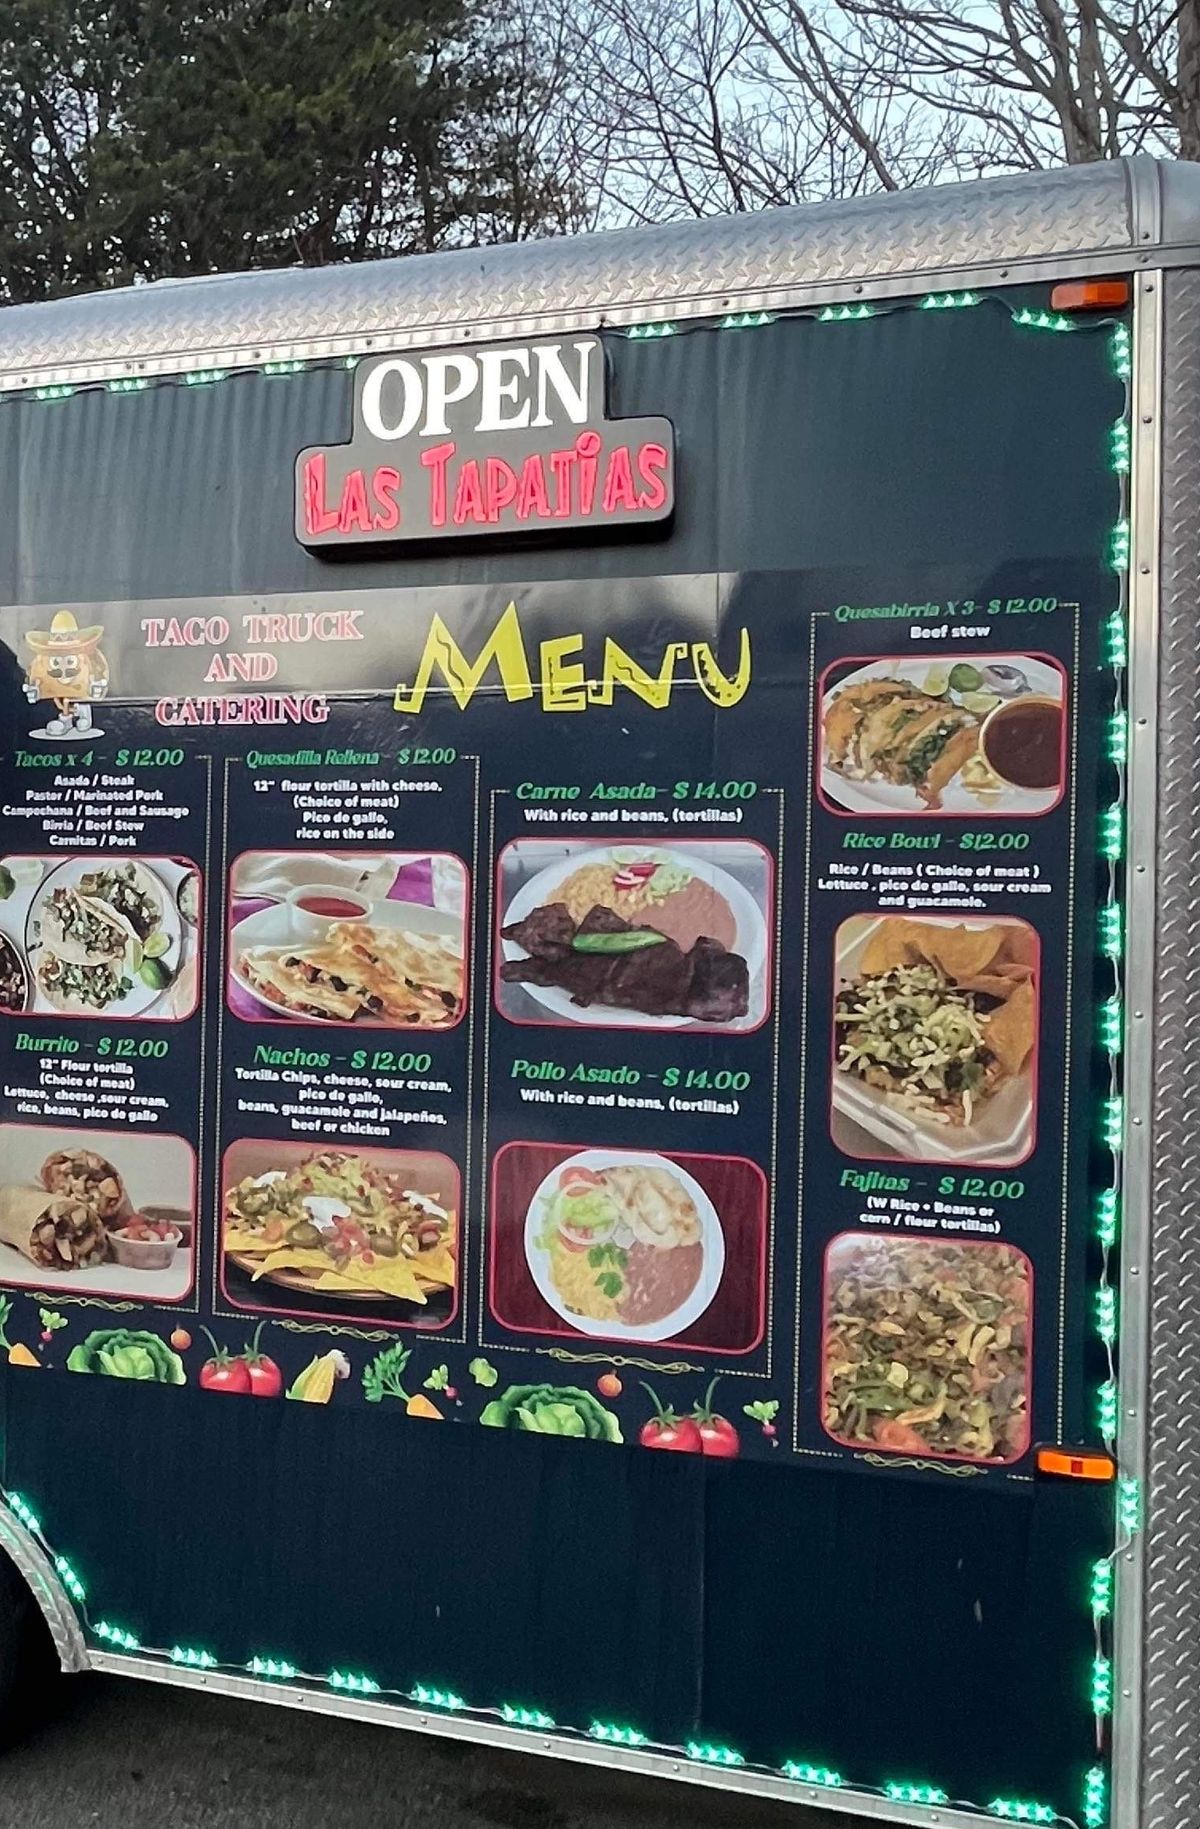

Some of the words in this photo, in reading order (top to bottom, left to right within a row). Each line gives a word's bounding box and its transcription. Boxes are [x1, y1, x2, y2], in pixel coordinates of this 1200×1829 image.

[361, 340, 597, 441] OPEN
[140, 616, 230, 648] TACO
[243, 610, 365, 644] TRUCK
[910, 625, 948, 639] Beef
[951, 626, 990, 637] stew
[203, 652, 278, 682] AND
[155, 694, 331, 727] CATERING
[15, 750, 63, 767] Tacos
[133, 749, 185, 766] 12.00
[246, 750, 321, 769] Quesadilla
[324, 749, 379, 765] Rellena
[412, 748, 456, 765] 12.00
[100, 775, 135, 786] Steak
[281, 779, 311, 792] flour
[313, 779, 358, 792] tortilla
[360, 779, 390, 792] with
[26, 790, 63, 801] Pastor
[73, 790, 133, 801] Marinated
[135, 790, 164, 801] Pork
[516, 782, 581, 800] Carne
[693, 781, 758, 800] 14.00
[293, 795, 341, 809] (Choice
[344, 795, 359, 808] of
[360, 795, 400, 809] meat)
[85, 805, 112, 816] Beef
[114, 805, 137, 816] and
[139, 805, 190, 819] Sausage
[302, 811, 331, 823] Pico
[333, 811, 350, 823] de
[524, 808, 559, 822] With
[560, 808, 588, 822] rice
[590, 809, 619, 822] and
[672, 807, 743, 823] (tortillas)
[85, 820, 112, 831] Beef
[114, 820, 145, 831] Stew
[296, 828, 321, 839] rice
[323, 830, 340, 839] on
[342, 828, 364, 839] the
[366, 827, 395, 839] side
[49, 835, 97, 846] Carnitas
[108, 835, 137, 846] Pork
[842, 832, 886, 850] Rice
[890, 833, 941, 850] Bowl
[829, 863, 859, 876] Rice
[871, 864, 914, 877] Beans
[925, 864, 973, 878] Choice
[975, 864, 992, 877] of
[994, 865, 1031, 878] meat
[818, 878, 869, 891] Lettuce
[879, 879, 909, 893] pico
[911, 879, 930, 892] de
[973, 883, 1004, 893] sour
[1007, 883, 1051, 894] cream
[878, 895, 905, 907] and
[15, 1033, 80, 1053] Burrito
[115, 1038, 169, 1058] 12.00
[253, 1045, 331, 1067] Nachos
[370, 1052, 432, 1073] 12.00
[61, 1060, 91, 1072] Flour
[93, 1062, 134, 1075] tortilla
[511, 1059, 566, 1082] Pollo
[569, 1062, 640, 1085] Asado
[685, 1069, 751, 1091] 14.00
[39, 1072, 84, 1086] (Choice
[85, 1077, 99, 1087] of
[100, 1077, 135, 1091] meat)
[235, 1067, 280, 1082] Tortilla
[281, 1069, 321, 1085] Chips,
[323, 1073, 373, 1088] cheese,
[375, 1078, 404, 1089] sour
[54, 1090, 96, 1102] cheese
[298, 1088, 327, 1101] pico
[328, 1089, 346, 1101] de
[520, 1088, 555, 1103] With
[557, 1091, 585, 1104] rice
[587, 1092, 615, 1107] and
[668, 1096, 740, 1115] (tortillas)
[83, 1108, 109, 1119] pico
[111, 1109, 126, 1120] de
[129, 1110, 159, 1122] gallo
[281, 1104, 351, 1117] guacamole
[353, 1108, 378, 1120] and
[292, 1118, 322, 1132] beef
[323, 1123, 338, 1132] or
[340, 1121, 391, 1136] chicken
[839, 1169, 911, 1193] Fajitas
[960, 1178, 1025, 1200] 12.00
[890, 1198, 920, 1212] Rice
[934, 1201, 977, 1216] Beans
[979, 1206, 994, 1217] or
[859, 1213, 891, 1226] corn
[904, 1215, 938, 1229] flour
[940, 1218, 1001, 1234] tortillas)
